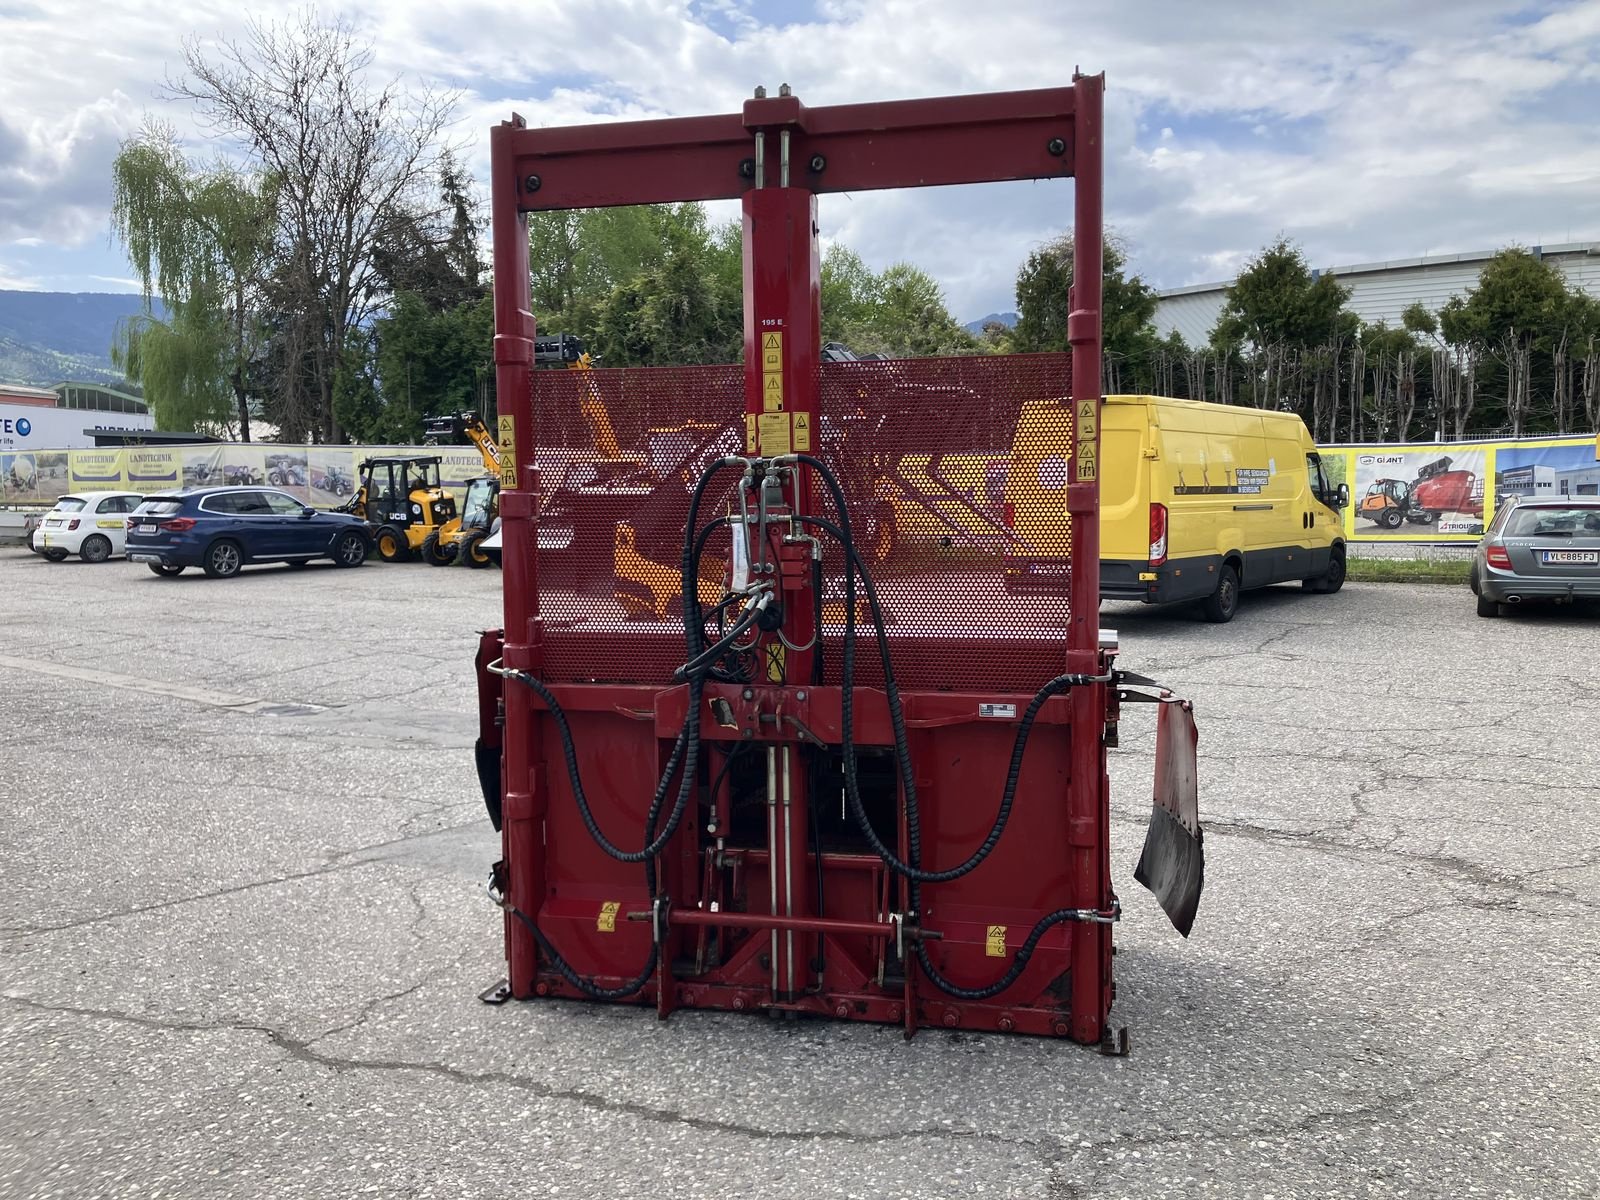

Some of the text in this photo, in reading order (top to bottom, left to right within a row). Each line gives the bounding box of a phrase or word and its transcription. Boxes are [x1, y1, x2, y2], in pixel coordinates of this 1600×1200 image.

[777, 318, 783, 326] E
[129, 453, 173, 462] LANDTECHNIK
[441, 456, 484, 465] LANDTECH
[389, 512, 407, 521] JCB
[1550, 553, 1560, 561] VL
